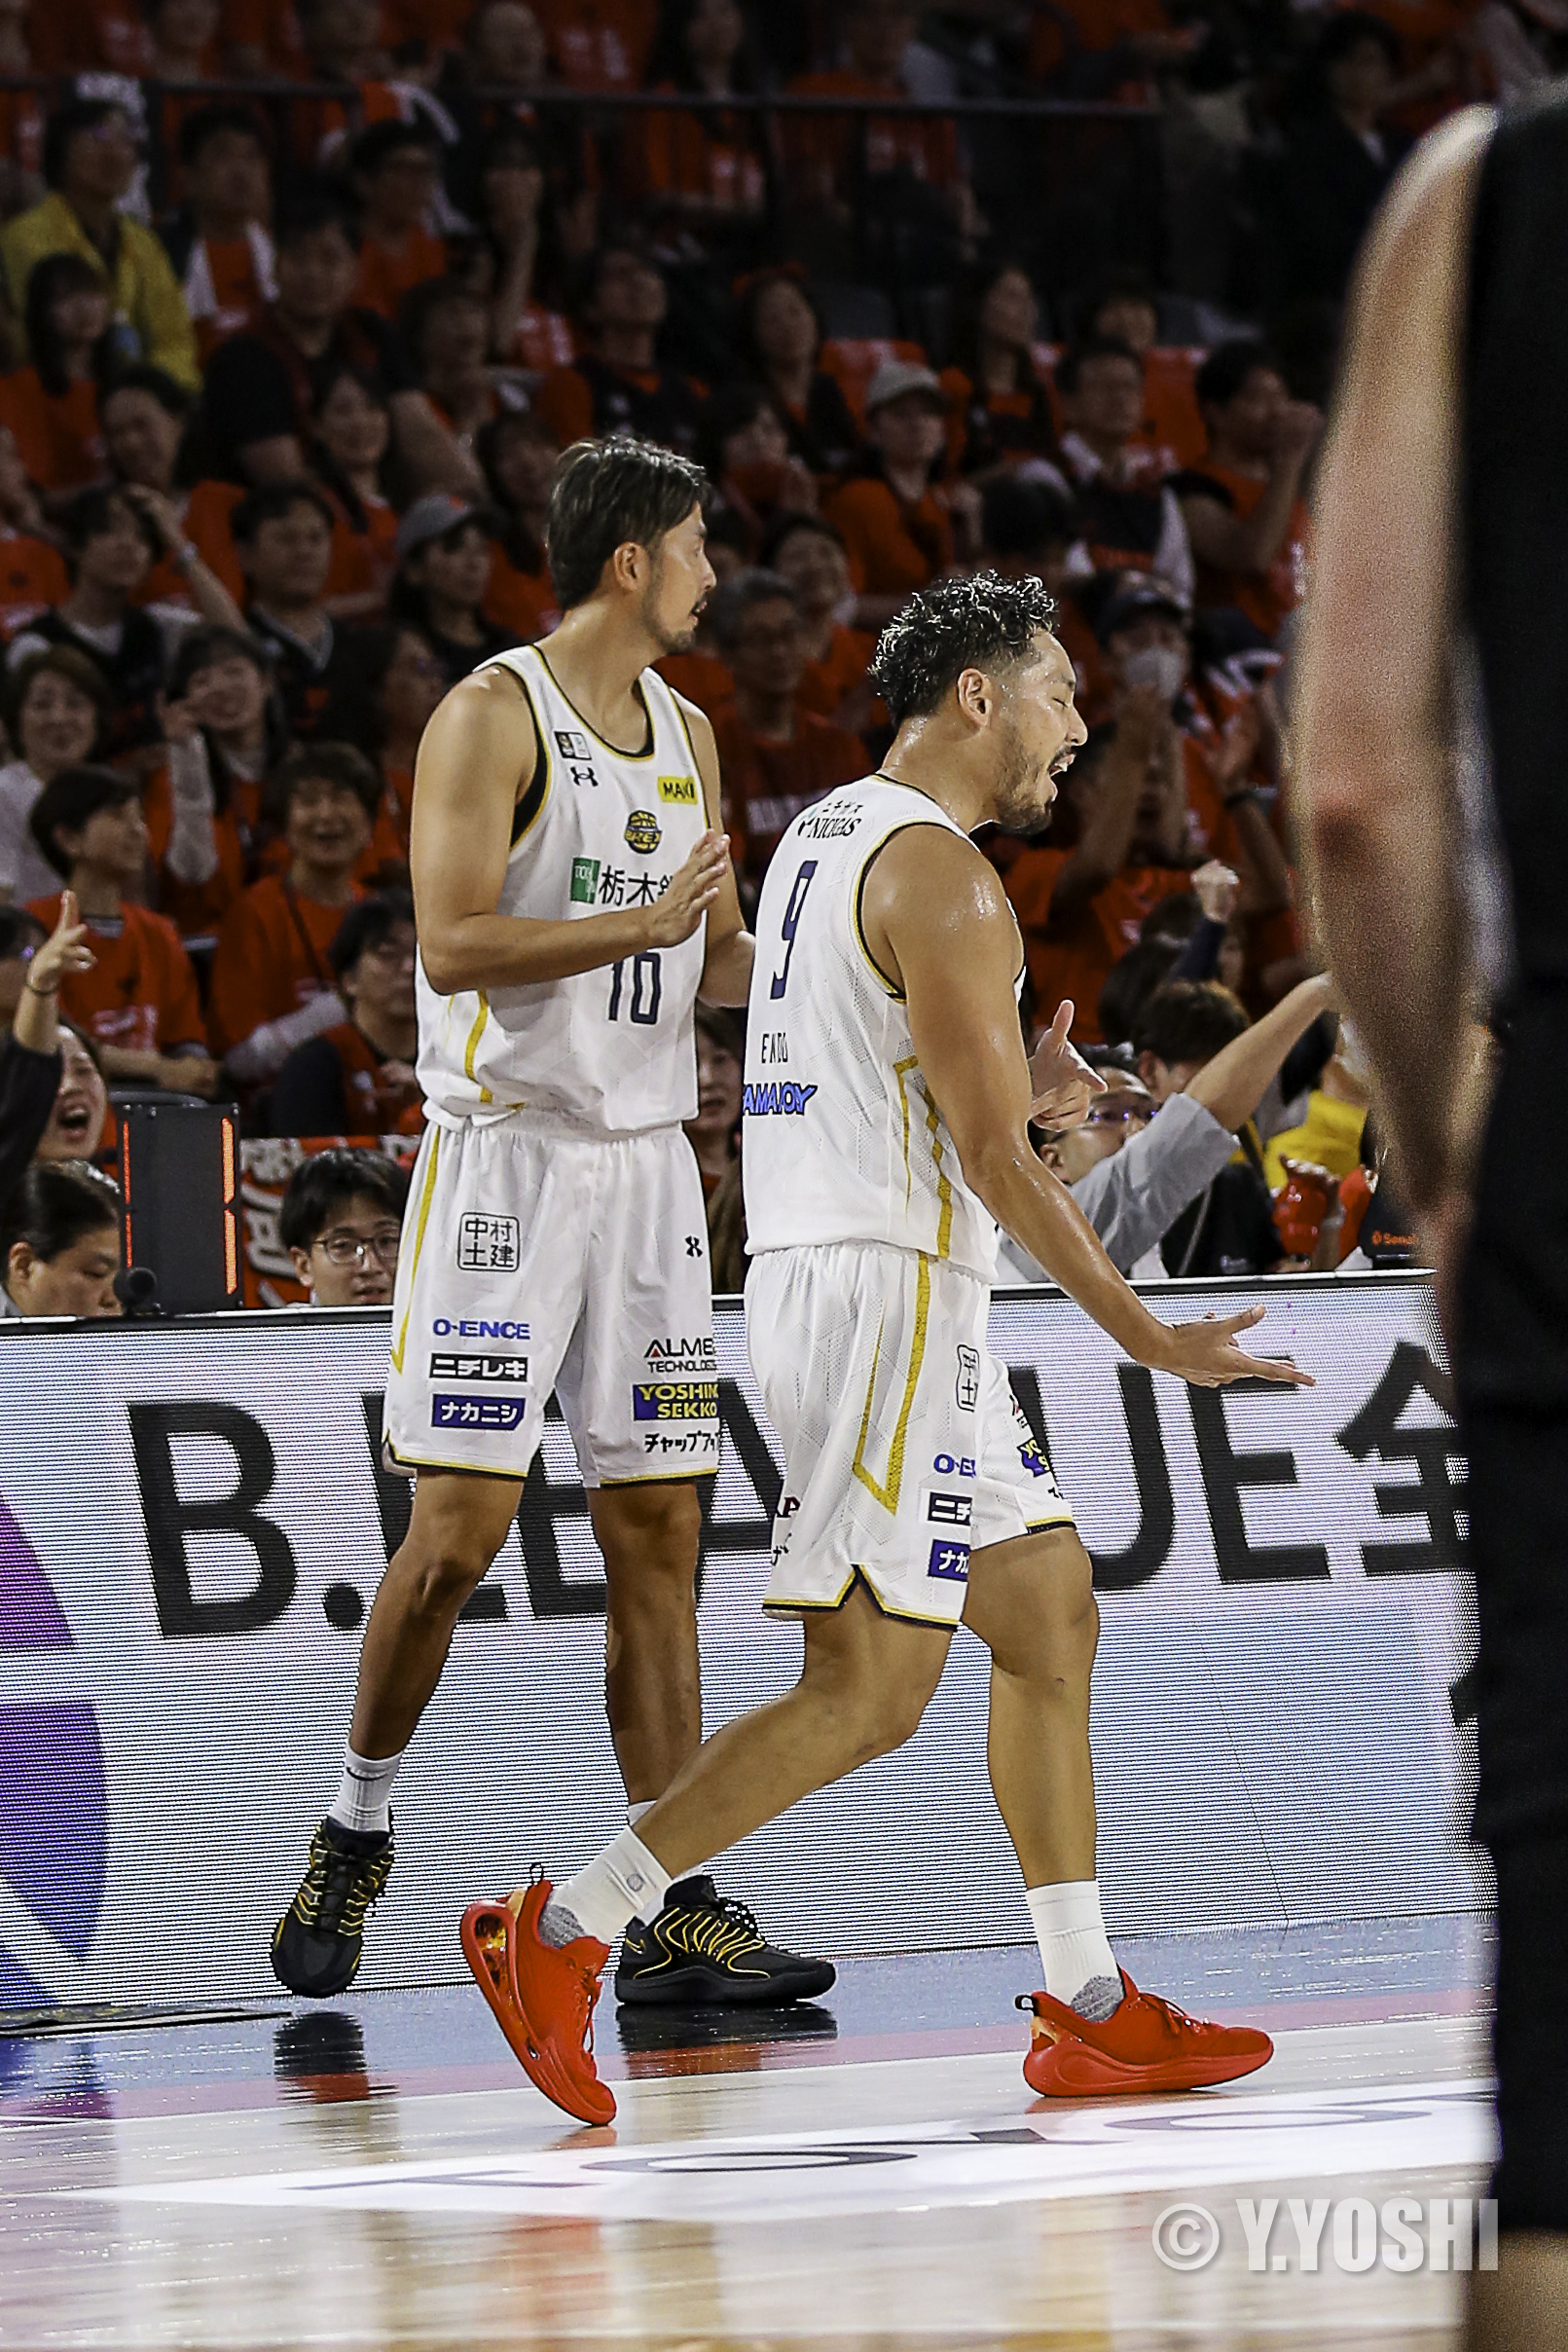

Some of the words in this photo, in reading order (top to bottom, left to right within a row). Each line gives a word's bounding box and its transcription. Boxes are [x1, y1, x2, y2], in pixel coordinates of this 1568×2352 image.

[769, 860, 819, 1000] 9
[607, 951, 662, 1025] 10
[464, 1217, 514, 1242] 中村
[462, 1242, 515, 1268] 土建
[432, 1317, 531, 1341] O-ENCE
[431, 1358, 528, 1379] ニチレキ
[440, 1402, 520, 1424] ナカニシ
[657, 1402, 718, 1418] SEKKO
